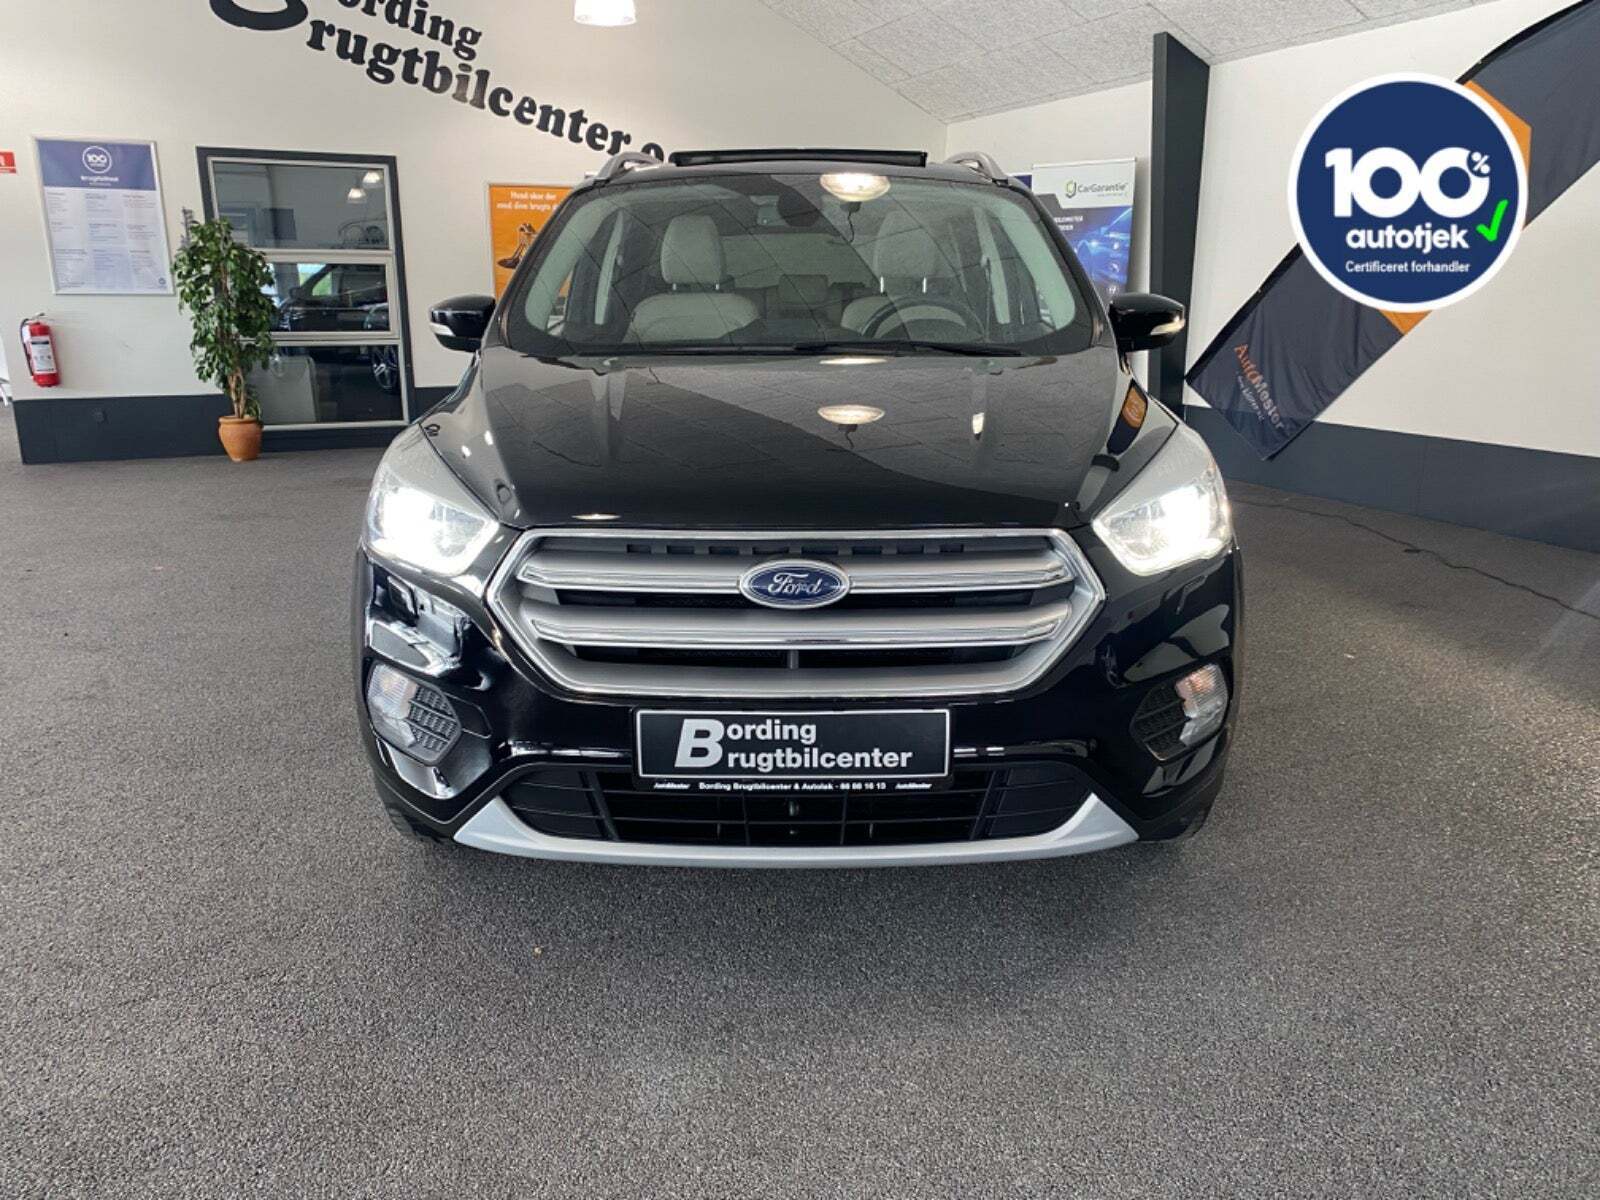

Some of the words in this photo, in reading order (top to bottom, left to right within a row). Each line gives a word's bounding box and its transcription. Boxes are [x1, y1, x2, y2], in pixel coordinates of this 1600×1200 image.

[1078, 183, 1126, 193] CarGarantie
[767, 572, 823, 595] Ford
[699, 782, 731, 791] Bording
